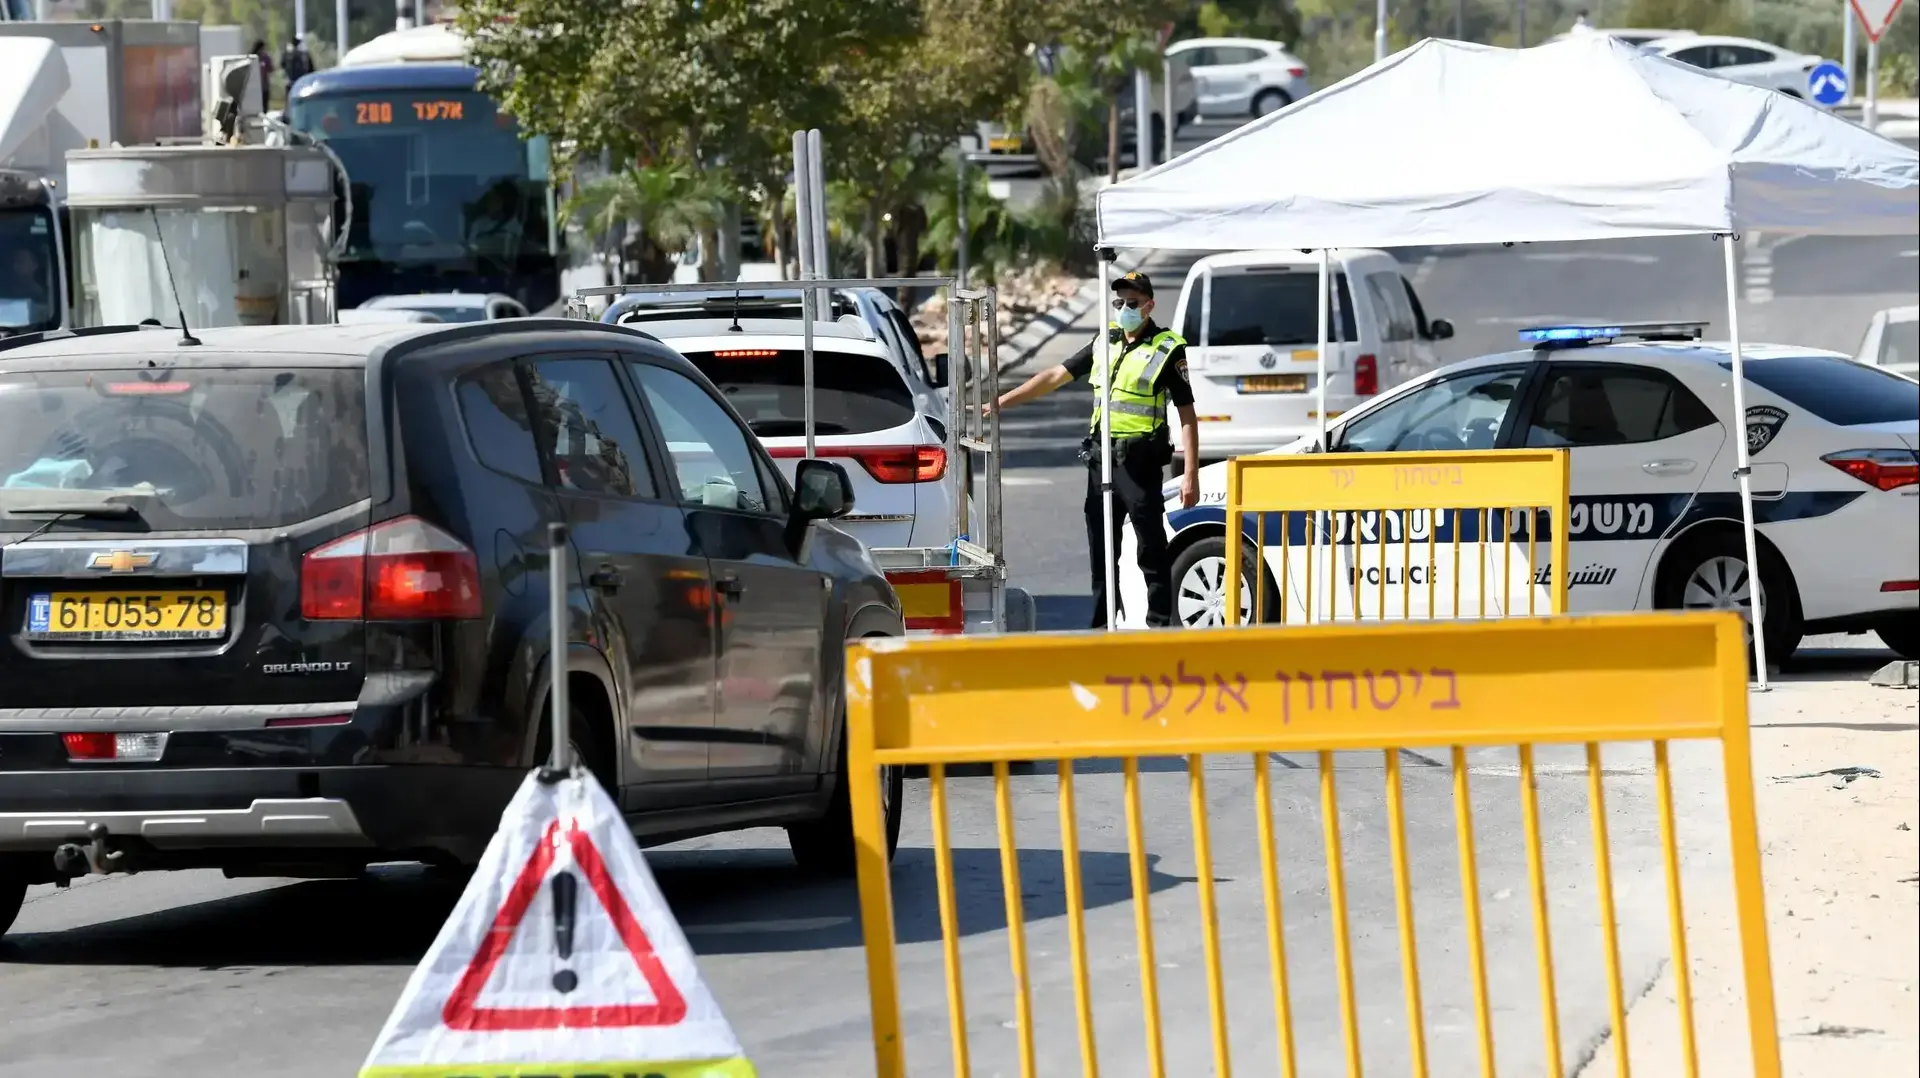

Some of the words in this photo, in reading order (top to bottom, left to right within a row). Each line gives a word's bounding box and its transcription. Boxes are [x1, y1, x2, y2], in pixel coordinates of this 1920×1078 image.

[412, 100, 463, 120] אלעד
[1393, 465, 1463, 491] ביטחון
[1350, 566, 1437, 585] POLICE
[263, 662, 332, 673] ORLANDO
[335, 661, 351, 671] LT
[1104, 660, 1249, 720] אלעד
[1275, 667, 1461, 725] ביטחון
